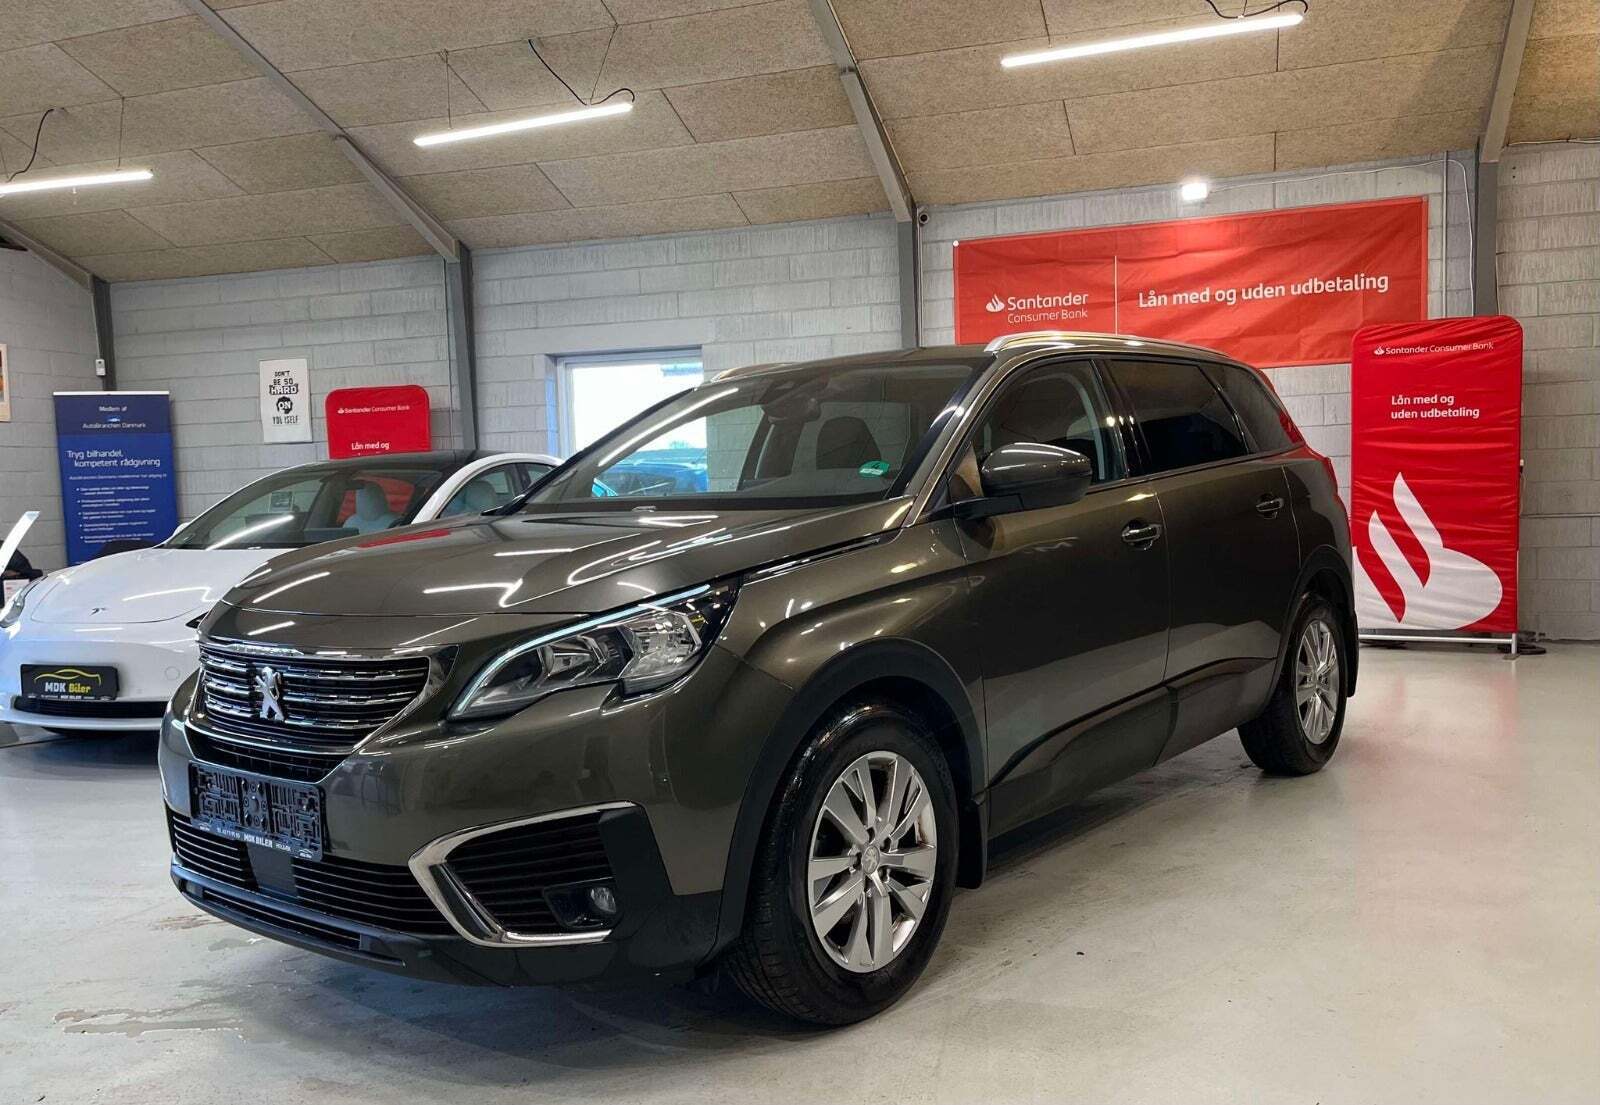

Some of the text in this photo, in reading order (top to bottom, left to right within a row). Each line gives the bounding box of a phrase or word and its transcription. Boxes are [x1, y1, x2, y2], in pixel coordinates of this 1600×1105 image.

[1139, 273, 1389, 307] Lån med og uden udbetaling
[1007, 292, 1089, 311] Santander
[1007, 308, 1088, 324] Consumer Bank
[1385, 342, 1494, 355] Santander Consumer Bank
[270, 385, 298, 395] HARD
[278, 401, 292, 410] ON
[1391, 394, 1454, 406] Lån med og
[1391, 407, 1480, 420] uden udbetaling
[351, 441, 364, 450] Lån
[364, 441, 379, 450] med
[67, 450, 84, 459] Tryg
[74, 459, 118, 467] kompetent
[44, 682, 92, 693] MDK Biler
[255, 837, 273, 848] BILER
